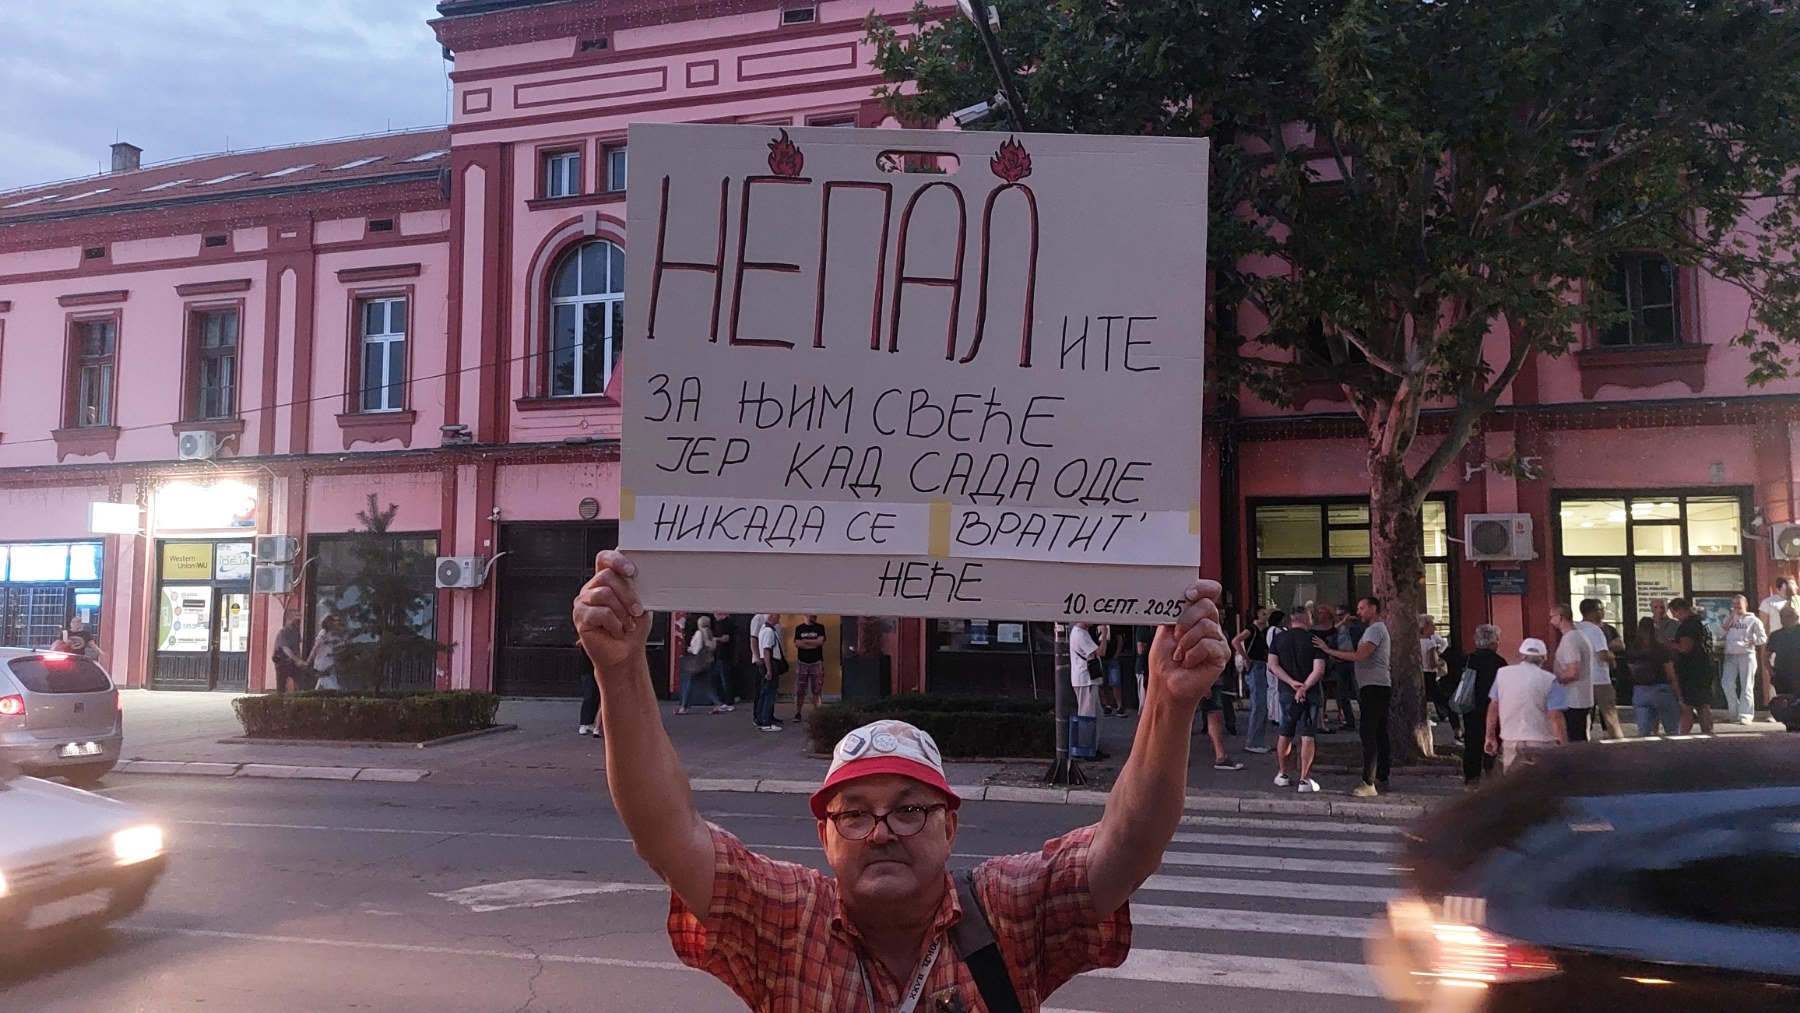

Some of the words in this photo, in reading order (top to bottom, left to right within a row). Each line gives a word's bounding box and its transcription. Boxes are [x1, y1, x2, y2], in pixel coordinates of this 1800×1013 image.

[647, 173, 1040, 370] НЕПАЛ
[1059, 314, 1161, 372] ИТЕ
[644, 373, 702, 423] ЗА
[738, 379, 854, 434] ЊИМ
[872, 386, 1066, 449] СВЕЋЕ
[656, 436, 751, 477] ЈЕР
[784, 441, 883, 499] КАД
[909, 451, 1041, 506] САДА
[1053, 456, 1153, 506] ОДЕ
[654, 502, 826, 549] НИКАДА
[845, 510, 898, 544] СЕ
[877, 560, 984, 603] НЕЋЕ
[1063, 592, 1090, 615] 10.
[1092, 597, 1139, 615] СЕПТ.
[1143, 598, 1187, 618] 2025
